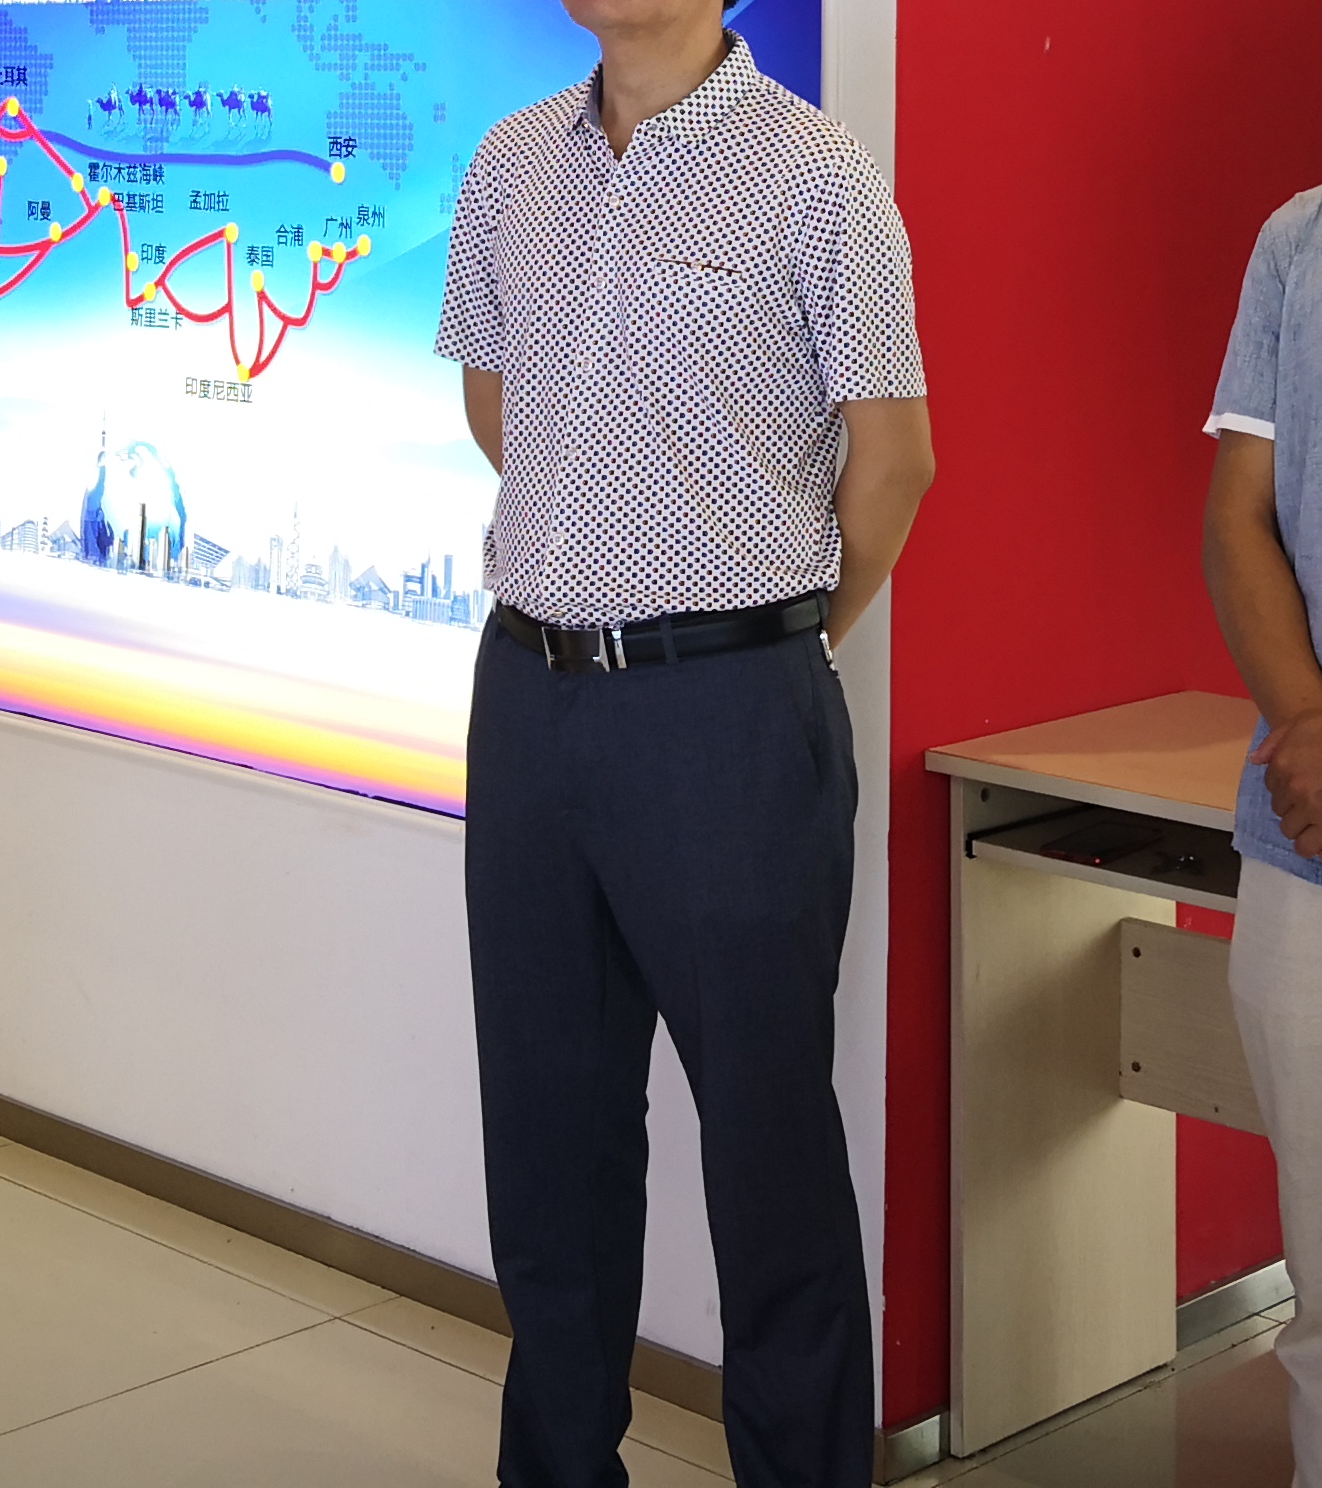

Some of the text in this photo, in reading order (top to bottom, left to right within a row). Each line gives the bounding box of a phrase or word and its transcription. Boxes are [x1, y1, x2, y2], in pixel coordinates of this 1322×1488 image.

[328, 136, 358, 158] 西安
[88, 162, 165, 185] 霍尔木兹海峡
[27, 200, 52, 221] 阿曼
[113, 192, 164, 214] 巴基斯坦
[189, 190, 229, 212] 孟加拉
[323, 216, 353, 239] 广州
[356, 204, 385, 228] 泉州
[275, 223, 304, 247] 合浦
[141, 243, 166, 265] 印度
[246, 244, 274, 267] 泰国
[130, 307, 184, 331] 斯里兰卡
[185, 376, 253, 404] 印度尼西亚
